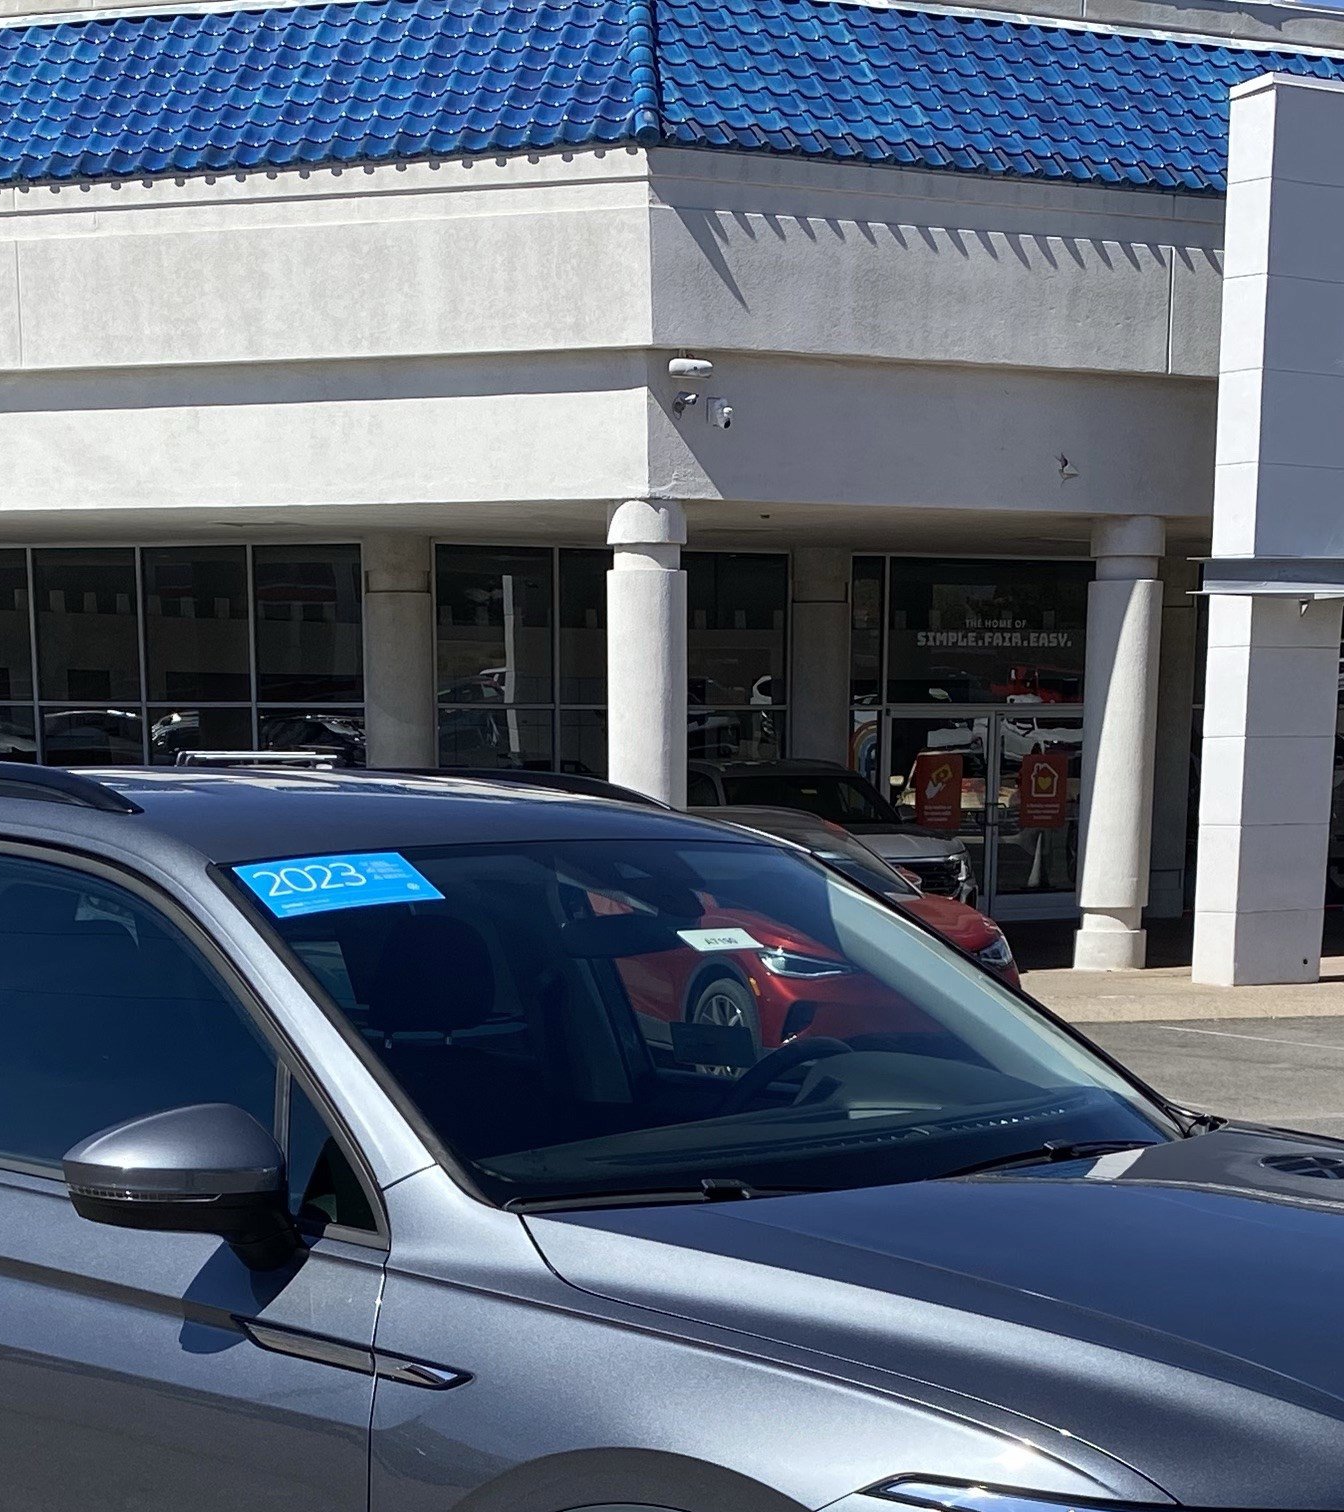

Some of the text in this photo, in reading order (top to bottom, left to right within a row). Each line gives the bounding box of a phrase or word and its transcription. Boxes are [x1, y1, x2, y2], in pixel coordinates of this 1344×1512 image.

[965, 619, 1026, 628] THE HOME OF
[253, 862, 367, 896] 2023
